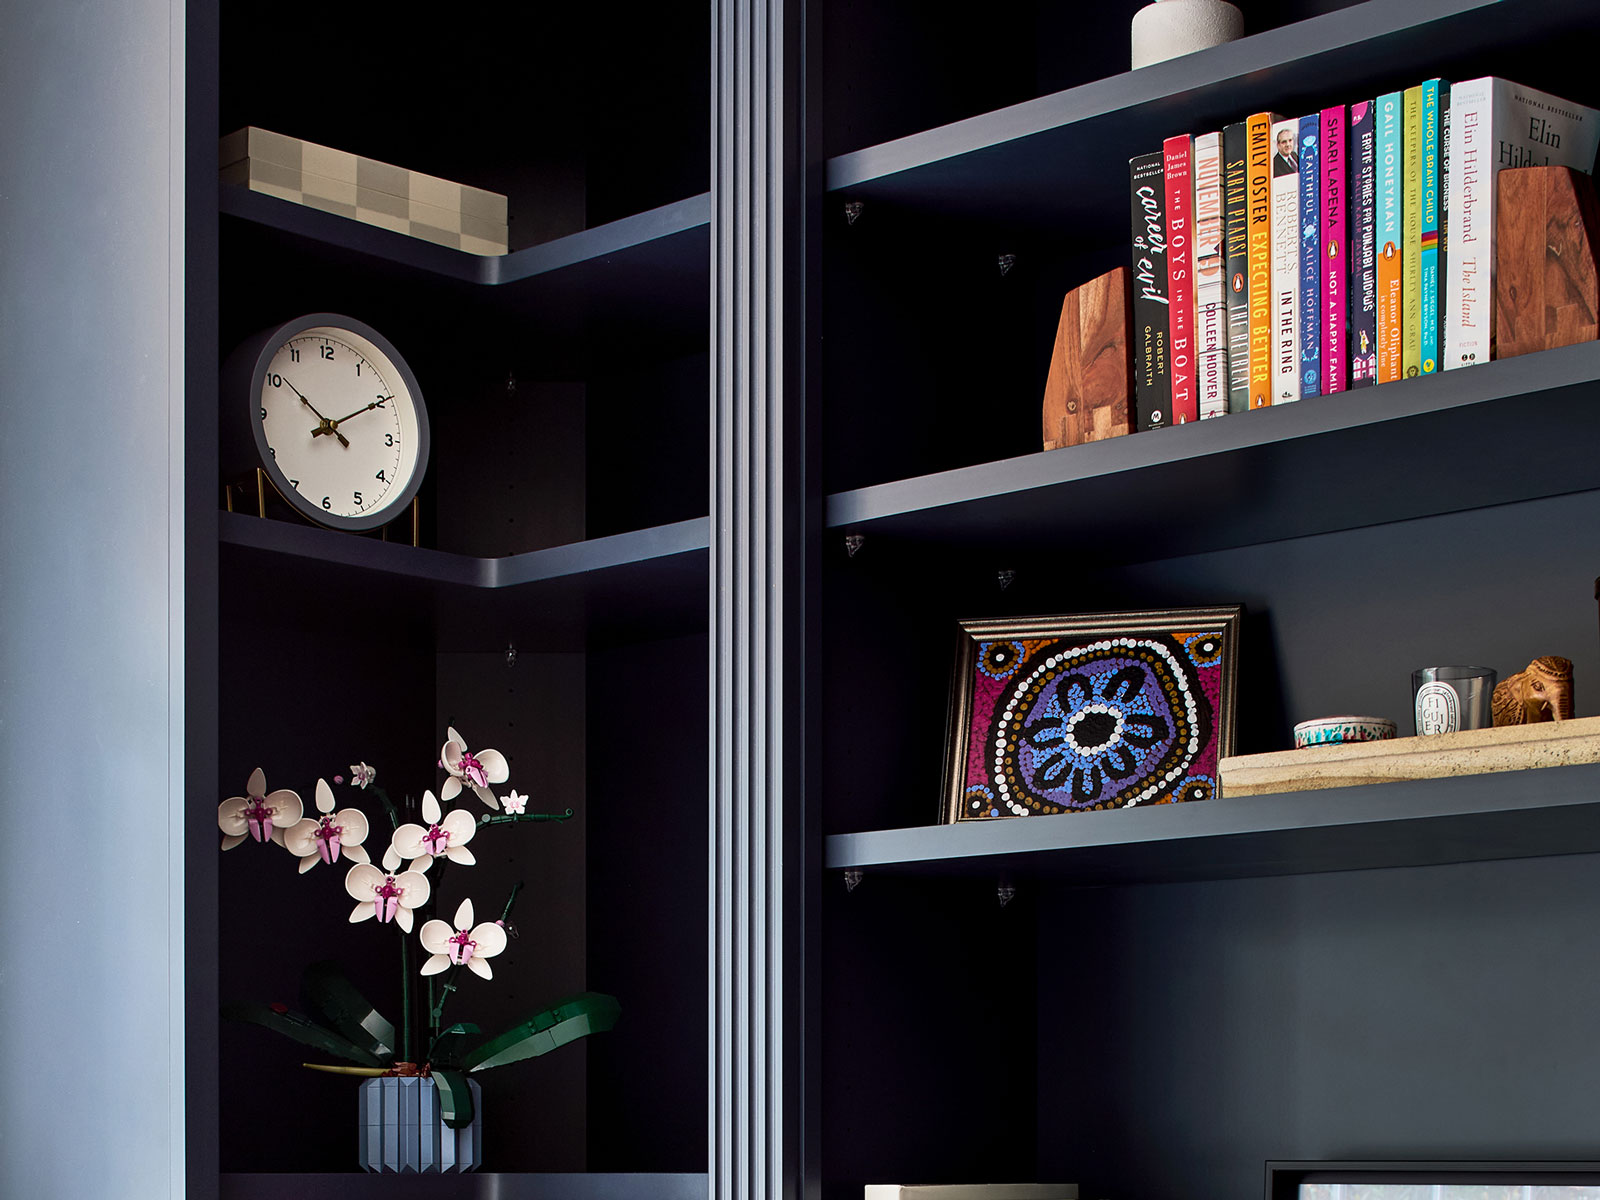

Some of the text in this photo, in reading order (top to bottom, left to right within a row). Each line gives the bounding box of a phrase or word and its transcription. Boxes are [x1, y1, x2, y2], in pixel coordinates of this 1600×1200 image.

[1409, 101, 1417, 119] THE
[1464, 112, 1478, 144] Elin
[1514, 94, 1583, 121] NATIONAL BESTSELLER
[1409, 124, 1417, 166] KEEPERS
[1528, 116, 1561, 149] Elin
[1133, 169, 1164, 180] BESTSELLER
[1136, 162, 1160, 171] NATIONAL
[1166, 152, 1187, 161] Daniel
[1167, 162, 1186, 171] James
[1252, 122, 1267, 224] EMILY OSTER
[1327, 118, 1339, 229] SHARI LAPENA
[1384, 102, 1395, 232] GAIL HONEYMAN
[1426, 86, 1434, 223] THE WHOLE-BRAIN CHILD
[1443, 158, 1450, 173] OF
[1167, 171, 1187, 180] Brown
[1306, 154, 1314, 215] FAITHFUL
[1409, 171, 1416, 182] OF
[1463, 149, 1478, 243] Hilderbrand
[1136, 186, 1168, 254] career
[1198, 157, 1219, 248] NOVEMBER
[1226, 160, 1246, 259] SARAH PEARSE
[1362, 132, 1375, 312] EROTIC STORIES FOR PUNJABI WIDOWS
[1171, 218, 1186, 280] BOYS
[1276, 193, 1286, 274] BENNETT
[1287, 191, 1298, 274] ROBERT S.
[1134, 236, 1170, 304] of evil
[1409, 252, 1417, 293] SHIRLEY
[1462, 257, 1477, 284] The
[1176, 290, 1182, 301] IN
[1252, 231, 1268, 384] EXPECTING BETTER
[1306, 246, 1314, 350] ALICE HOFFMAN
[1462, 287, 1477, 328] Island
[1230, 303, 1249, 392] THE RETREAT
[1281, 291, 1293, 374] IN THE RING
[1329, 271, 1338, 394] NOT A HAPPY FAMIL
[1379, 304, 1388, 350] completely
[1388, 279, 1400, 380] Eleanor Oliphant
[290, 349, 300, 362] 11
[320, 345, 335, 360] 12
[356, 364, 361, 376] 1
[1144, 326, 1153, 386] GALBRAITH
[1156, 332, 1164, 375] ROBERT
[1174, 337, 1188, 400] BOAT
[1205, 303, 1217, 399] COLLEEN HOOVER
[1380, 352, 1388, 368] fine
[267, 373, 282, 388] 10
[260, 407, 268, 420] 9
[376, 395, 386, 408] 2
[385, 433, 394, 447] 3
[375, 470, 386, 482] 4
[322, 496, 331, 509] 6
[353, 492, 363, 505] 5
[1423, 709, 1444, 724] GUI
[1428, 697, 1439, 708] FI
